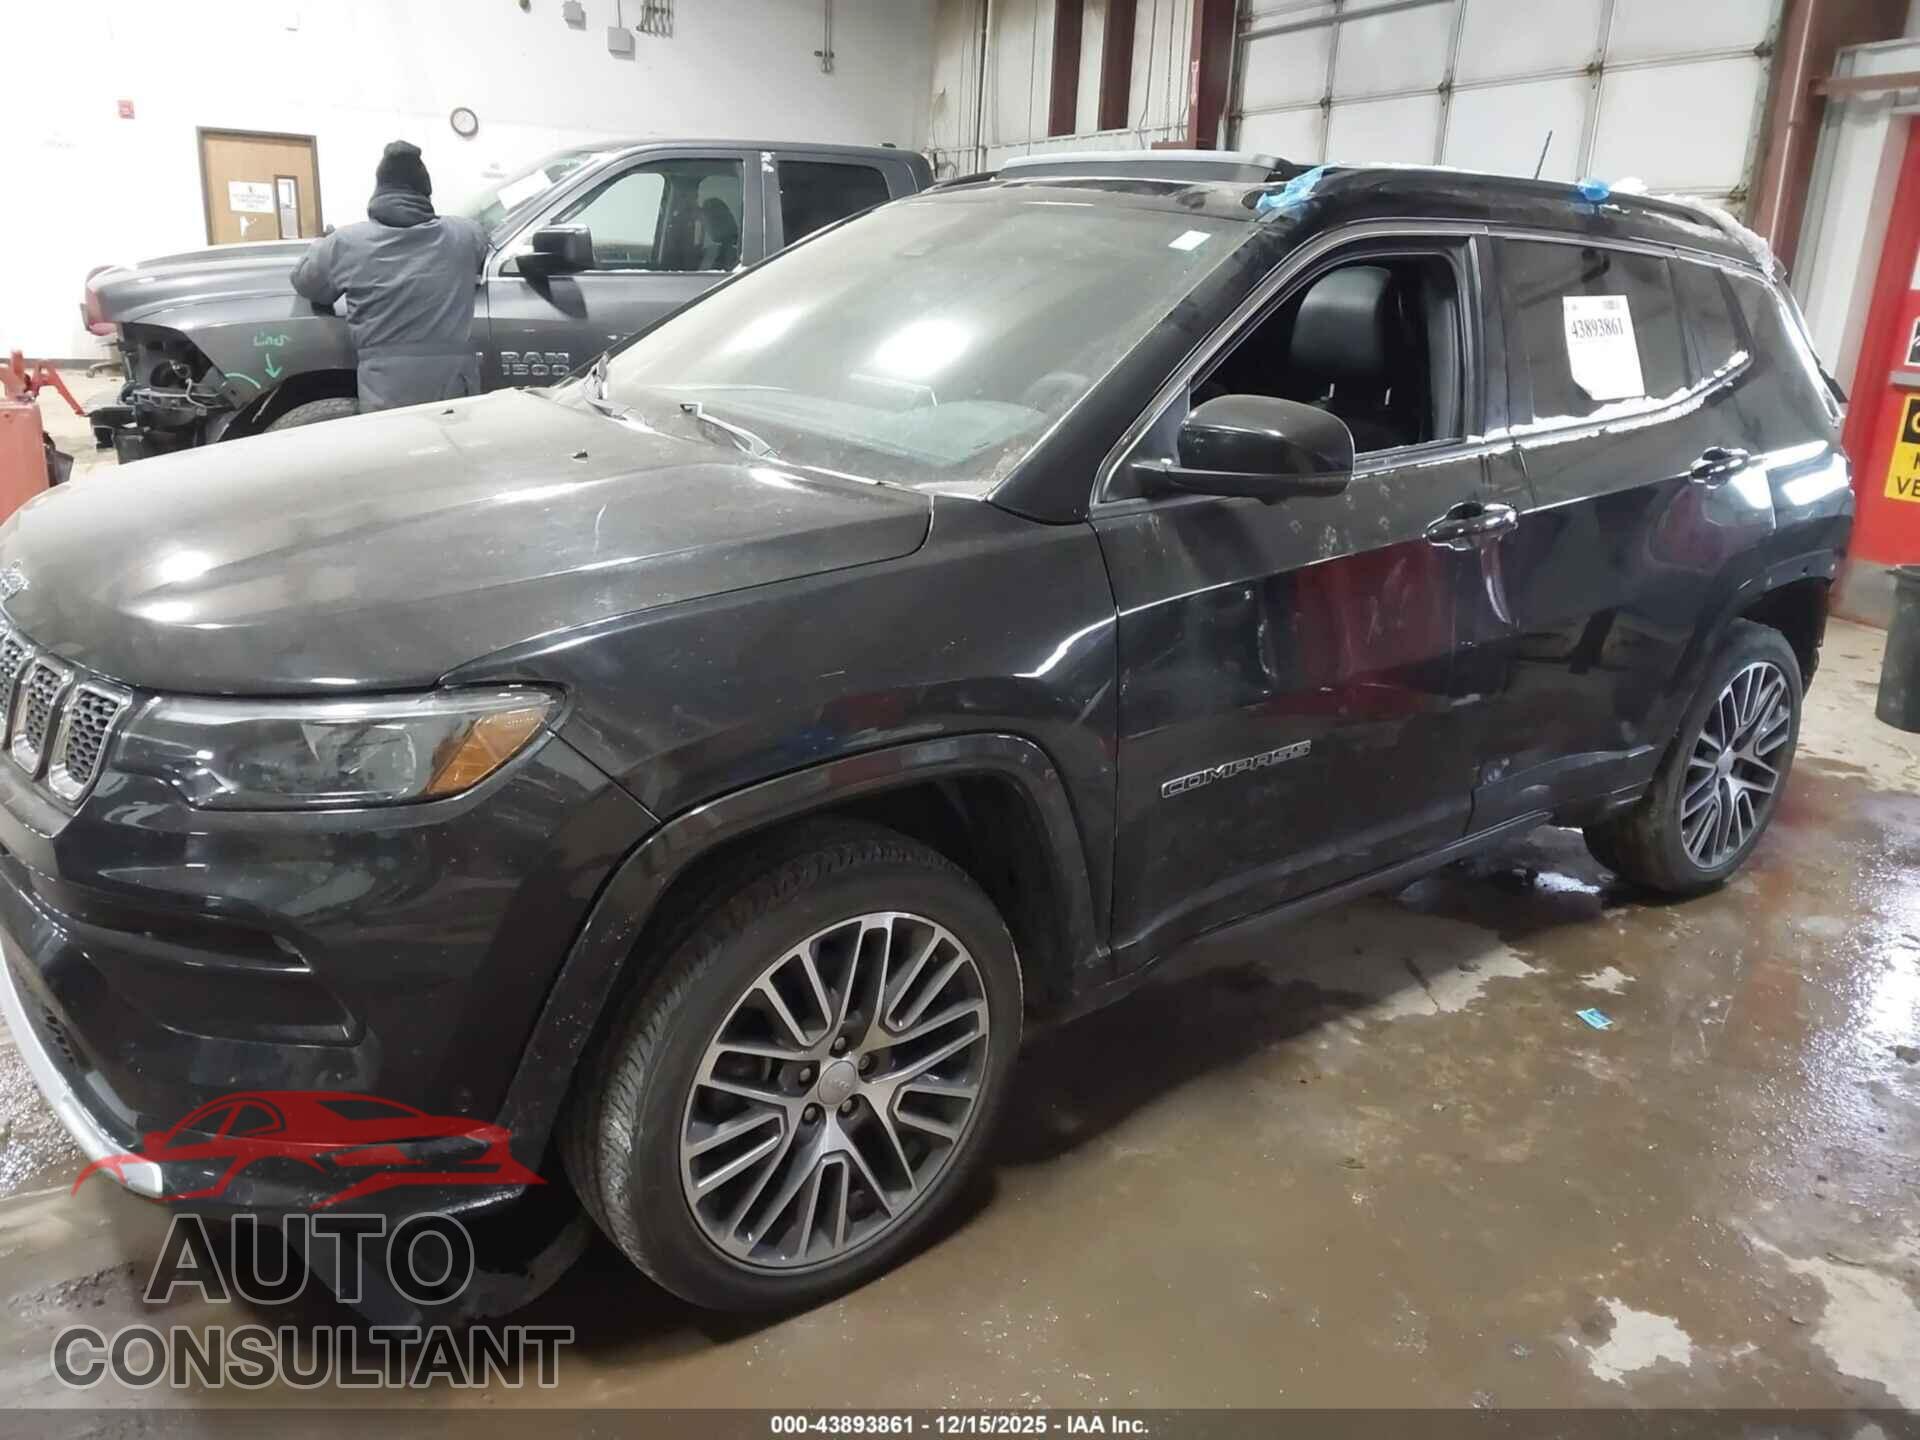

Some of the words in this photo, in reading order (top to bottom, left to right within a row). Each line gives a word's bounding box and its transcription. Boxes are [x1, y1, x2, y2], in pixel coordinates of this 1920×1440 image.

[1571, 317, 1624, 339] 43893861
[500, 351, 569, 364] RAM
[501, 363, 570, 377] 1500
[1161, 739, 1312, 799] COMPASS
